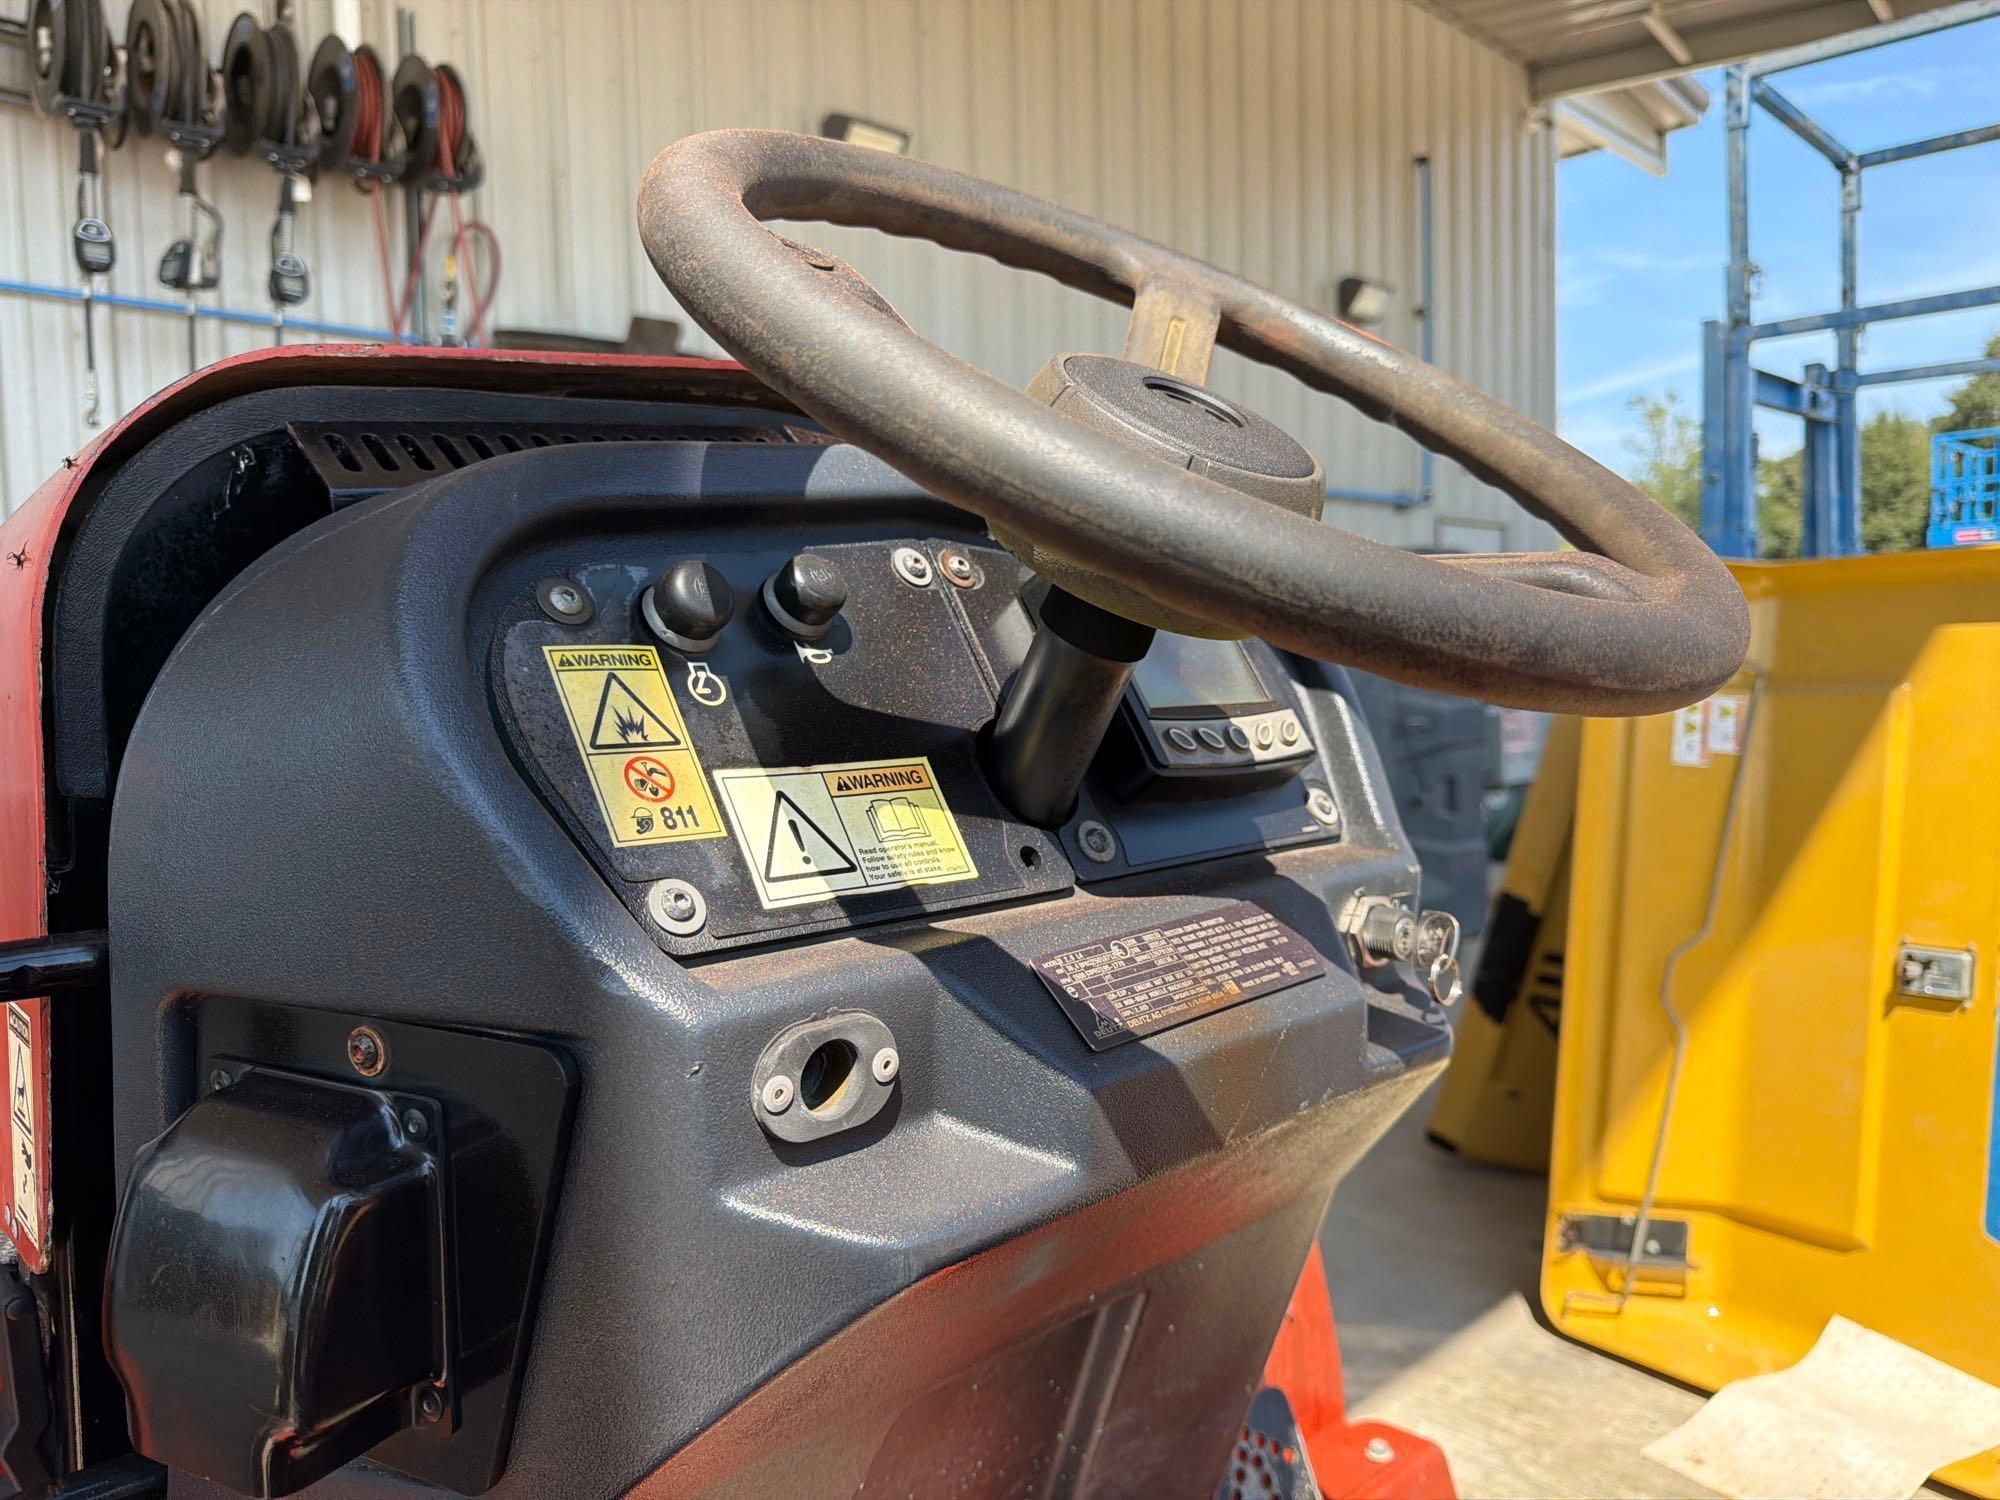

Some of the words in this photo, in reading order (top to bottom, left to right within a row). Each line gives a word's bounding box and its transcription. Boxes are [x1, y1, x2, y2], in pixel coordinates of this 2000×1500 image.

[572, 654, 652, 667] WARNING
[847, 770, 923, 789] WARNING
[660, 805, 700, 830] 811
[862, 854, 886, 863] Follow
[882, 862, 889, 870] to
[869, 873, 886, 881] Your
[887, 869, 908, 878] safety
[1126, 1016, 1151, 1029] DEUTZ
[1151, 1011, 1162, 1020] AG
[1094, 1024, 1126, 1037] DEUTZ
